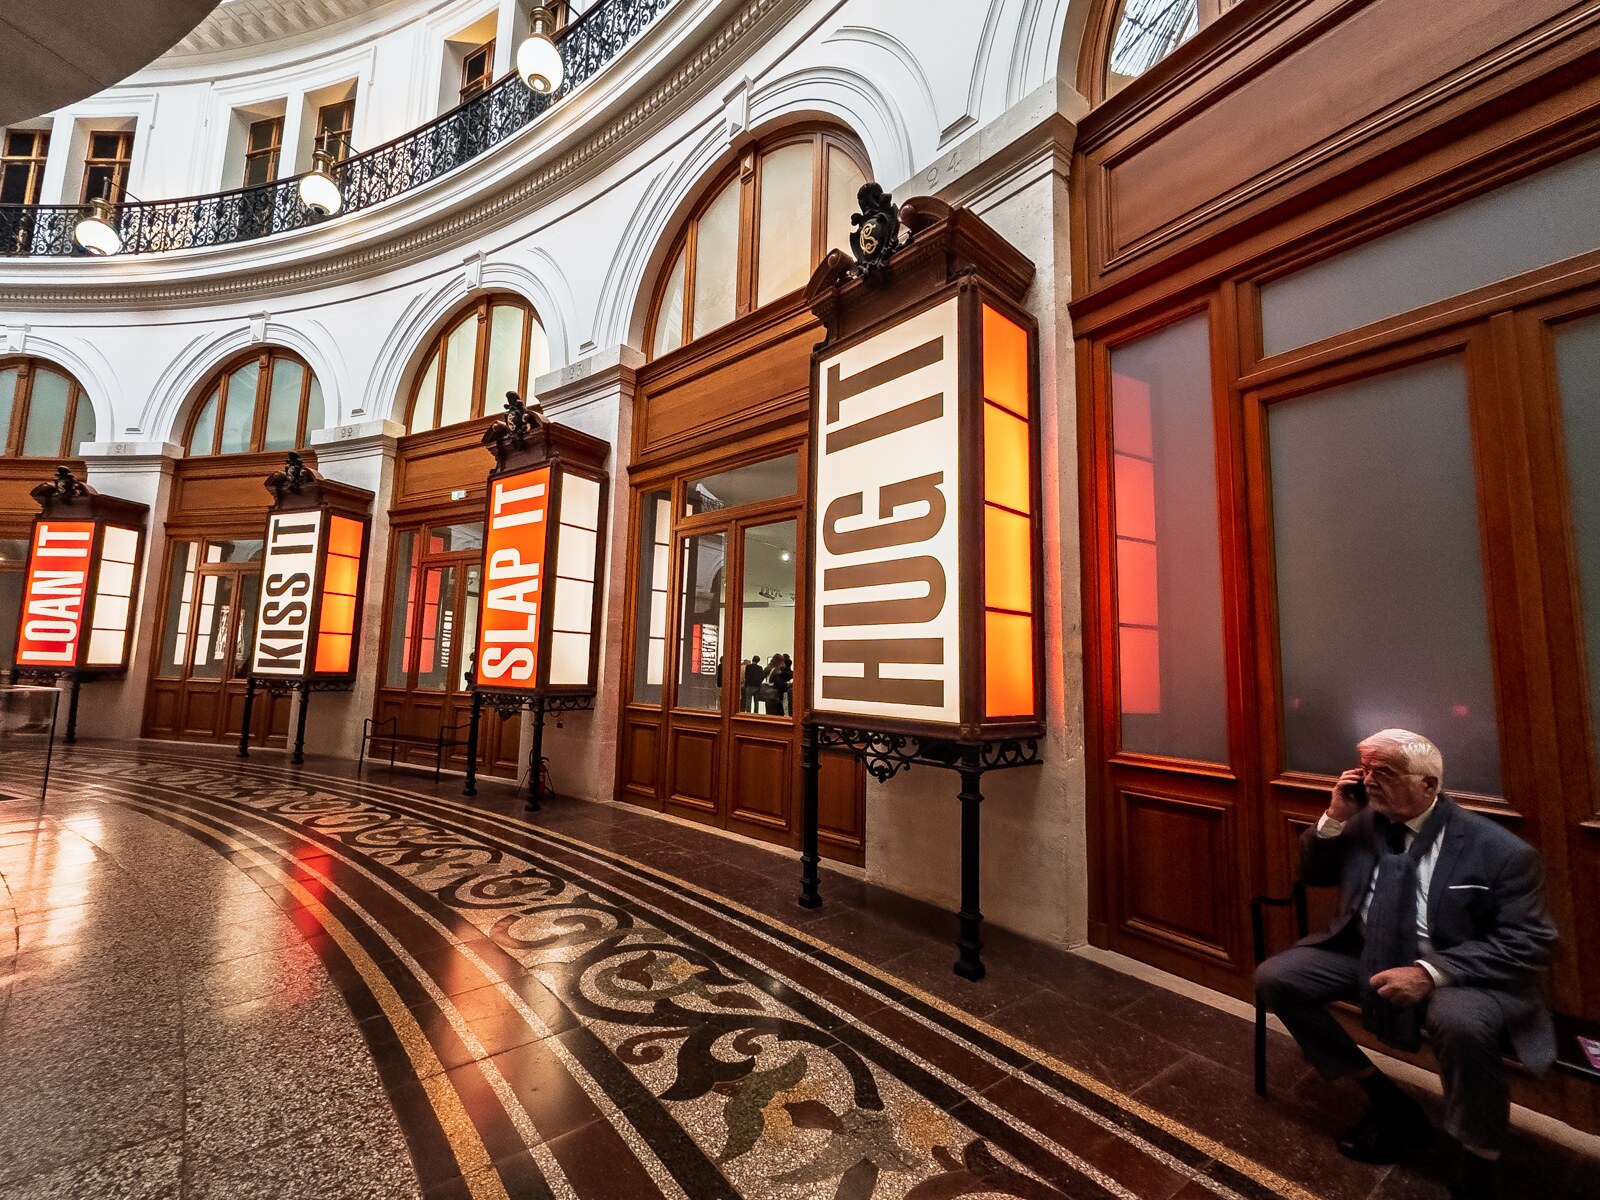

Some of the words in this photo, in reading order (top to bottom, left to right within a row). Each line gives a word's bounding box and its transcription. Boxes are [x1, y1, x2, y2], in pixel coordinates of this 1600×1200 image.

[826, 335, 944, 456] IT
[36, 525, 92, 558] IT
[270, 519, 316, 556] IT
[493, 483, 546, 530] IT
[21, 570, 85, 662] LOAN
[257, 572, 311, 670] KISS
[481, 547, 540, 680] SLAP
[821, 470, 947, 708] HUG
